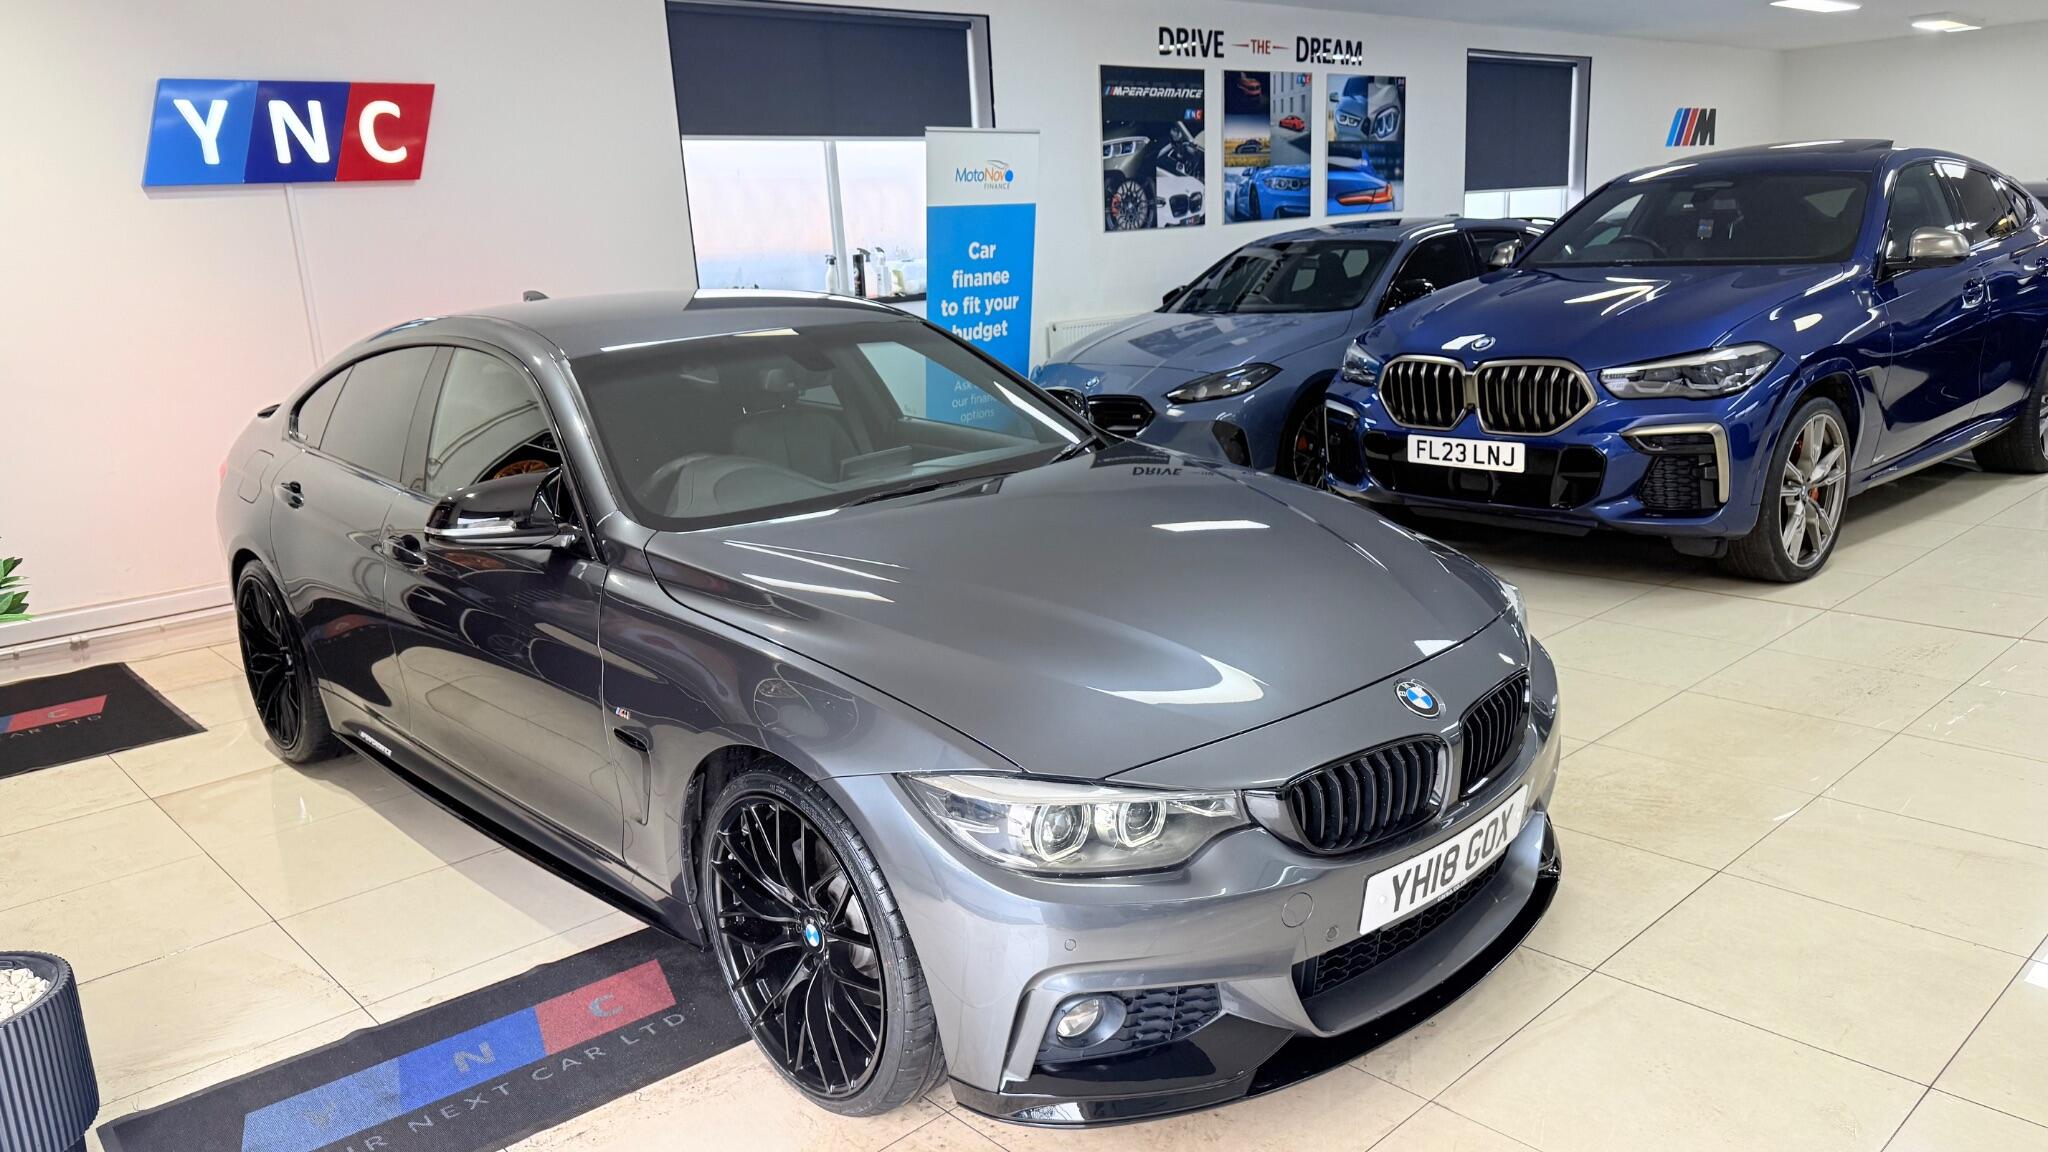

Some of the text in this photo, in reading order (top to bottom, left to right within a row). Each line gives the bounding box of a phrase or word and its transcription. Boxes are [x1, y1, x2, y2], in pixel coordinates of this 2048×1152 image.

[1158, 27, 1363, 66] DRIVE THE DREAM
[173, 98, 408, 165] YNC
[983, 183, 1011, 191] FINANCE
[968, 241, 997, 260] Car
[952, 269, 1010, 289] finance
[941, 295, 1019, 317] to fit your
[952, 319, 1009, 342] budget
[951, 392, 993, 408] our finan
[960, 409, 995, 424] options
[1416, 439, 1515, 467] FL23 LNJ
[1392, 802, 1515, 914] YH18 GOX
[407, 1013, 685, 1133] NEXT CAR LTD
